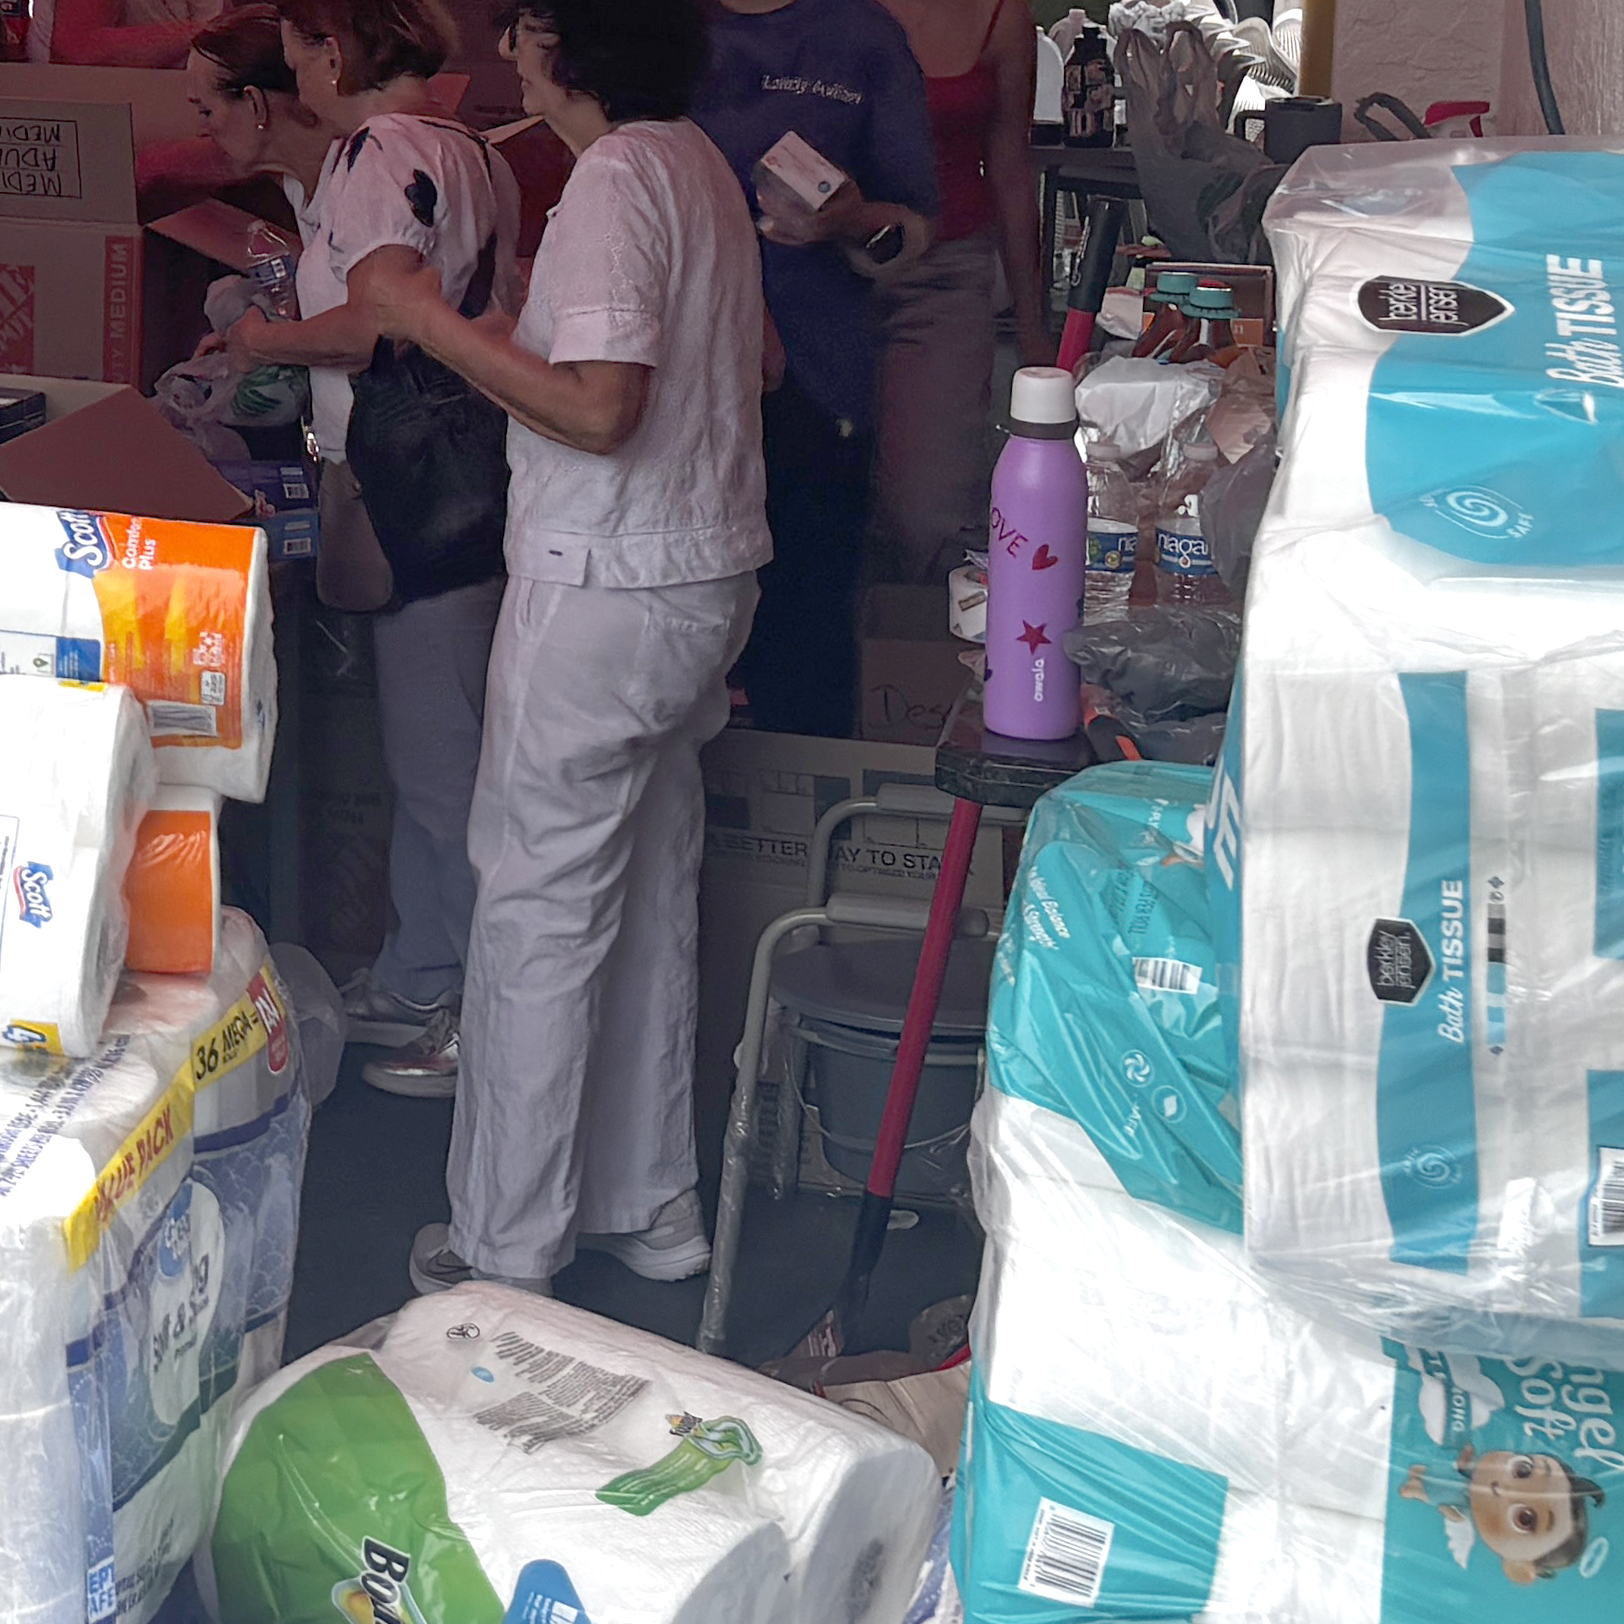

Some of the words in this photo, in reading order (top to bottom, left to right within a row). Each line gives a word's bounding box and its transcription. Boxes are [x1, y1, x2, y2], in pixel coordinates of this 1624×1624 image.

[109, 242, 129, 339] MEDIUM
[1546, 253, 1617, 336] TISSUE
[63, 510, 103, 567] Scott
[139, 538, 157, 570] Plus
[991, 507, 1028, 558] OVE
[1033, 658, 1045, 703] owala
[866, 847, 896, 867] TO
[21, 868, 53, 920] Scott
[1376, 930, 1397, 987] berkley
[1441, 879, 1464, 982] TISSUE
[1437, 986, 1465, 1045] Bath
[195, 1036, 221, 1081] 36
[134, 1104, 176, 1171] PACK
[1504, 1354, 1577, 1440] Soft
